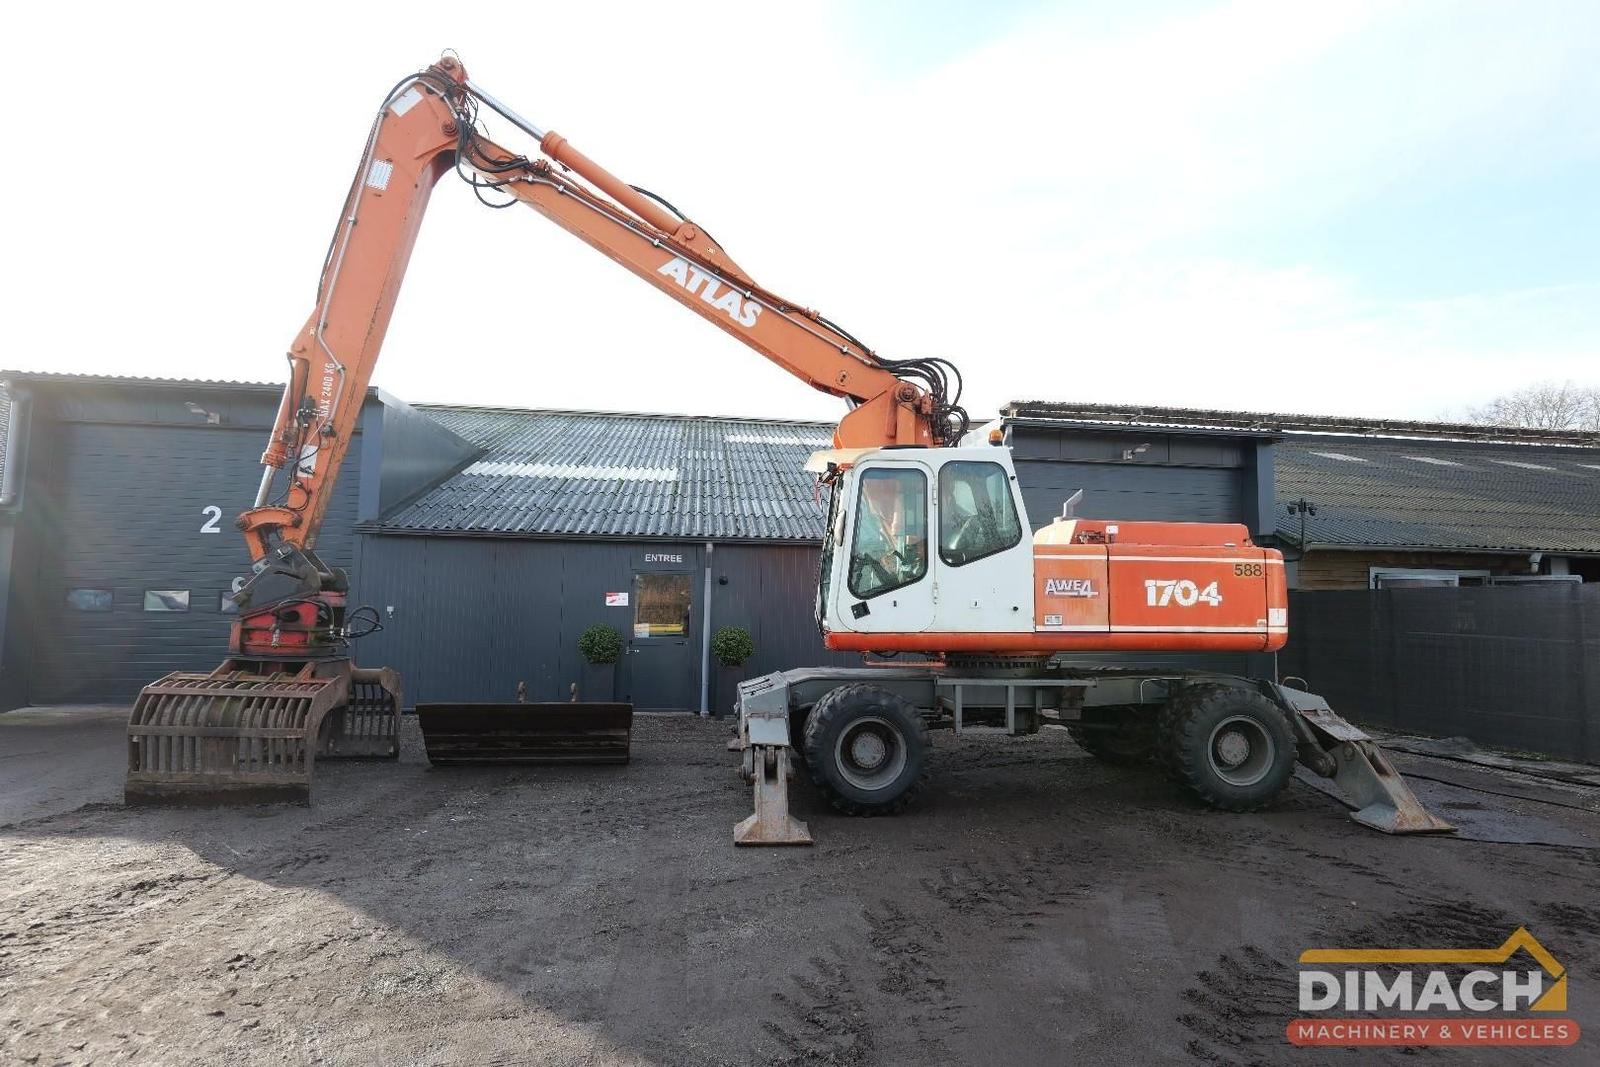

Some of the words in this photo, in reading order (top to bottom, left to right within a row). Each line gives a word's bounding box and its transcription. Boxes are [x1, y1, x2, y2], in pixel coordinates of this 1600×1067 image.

[657, 257, 762, 328] ATLAS
[322, 376, 333, 397] 2400
[319, 399, 330, 417] MAX
[200, 505, 222, 533] 2
[645, 553, 682, 563] ENTREE
[1234, 563, 1263, 577] 588
[1144, 579, 1223, 607] 1704
